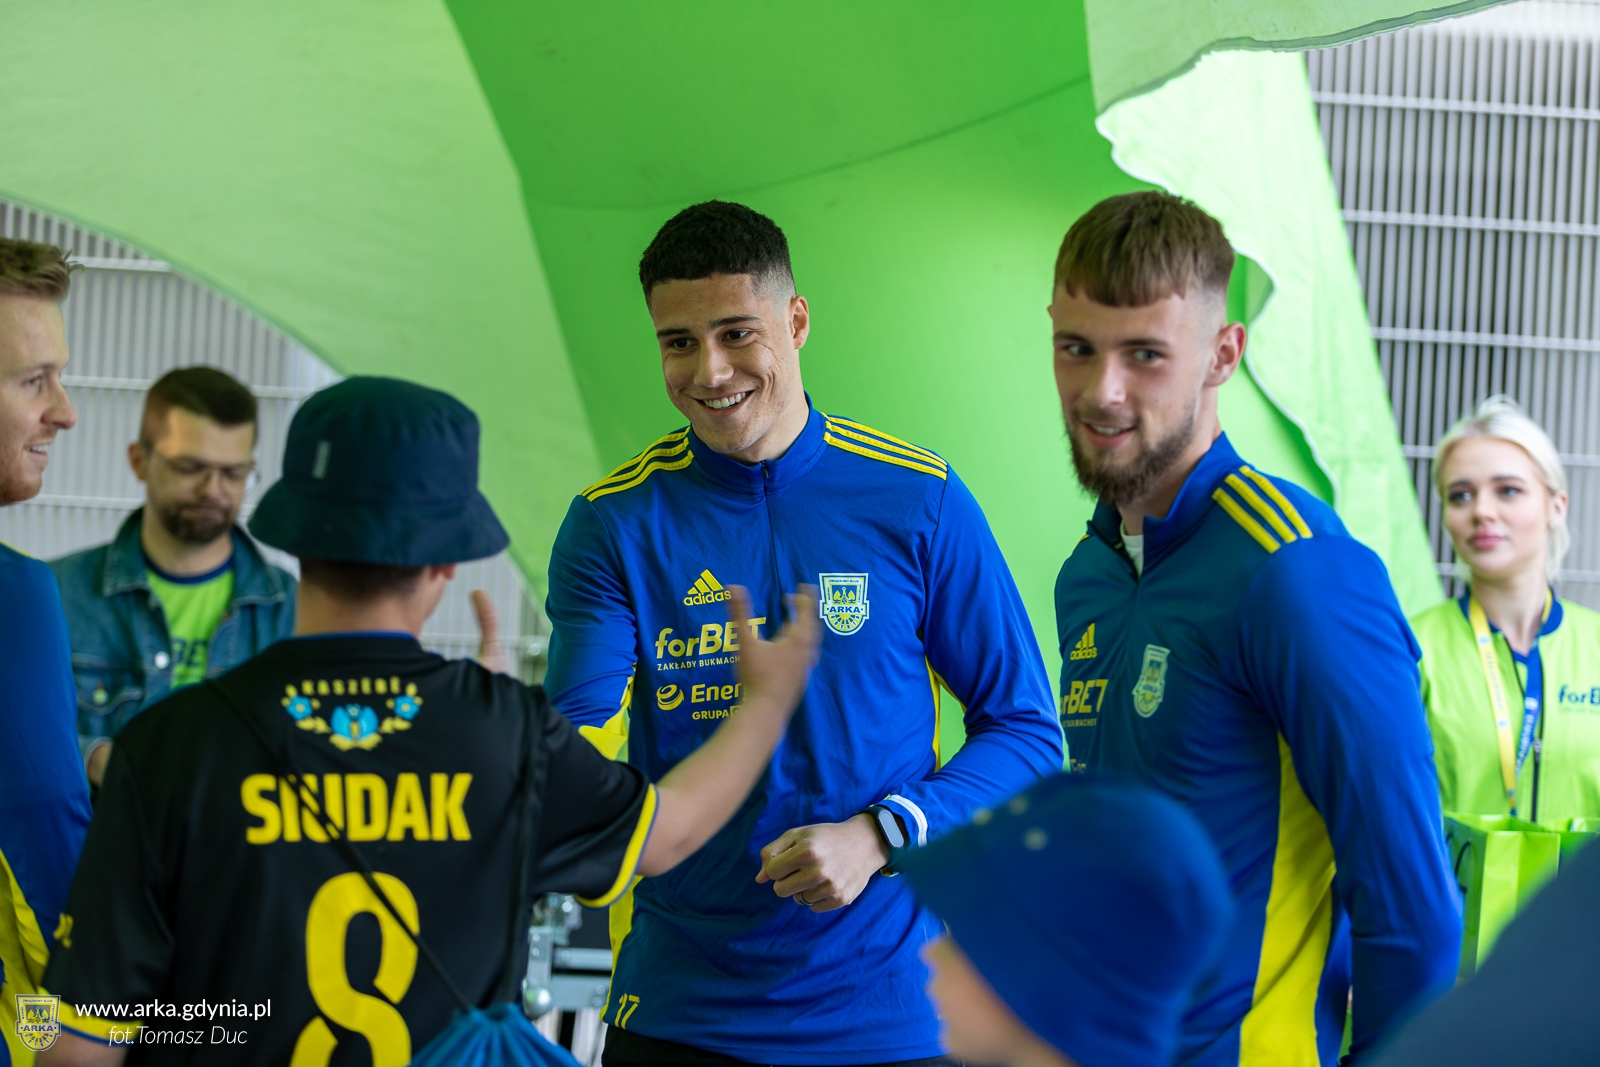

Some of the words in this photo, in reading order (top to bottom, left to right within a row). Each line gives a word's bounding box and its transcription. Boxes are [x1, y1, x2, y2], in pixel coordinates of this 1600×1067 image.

[683, 590, 732, 606] adidas
[655, 616, 767, 659] forBET
[657, 661, 697, 671] ZAKŁADY
[699, 655, 741, 667] BUKMACH
[1070, 647, 1098, 660] adidas
[691, 682, 745, 704] Ener
[692, 709, 729, 720] GRUPA
[240, 772, 474, 845] SIUDAK
[290, 871, 420, 1067] 8
[615, 993, 640, 1030] 17
